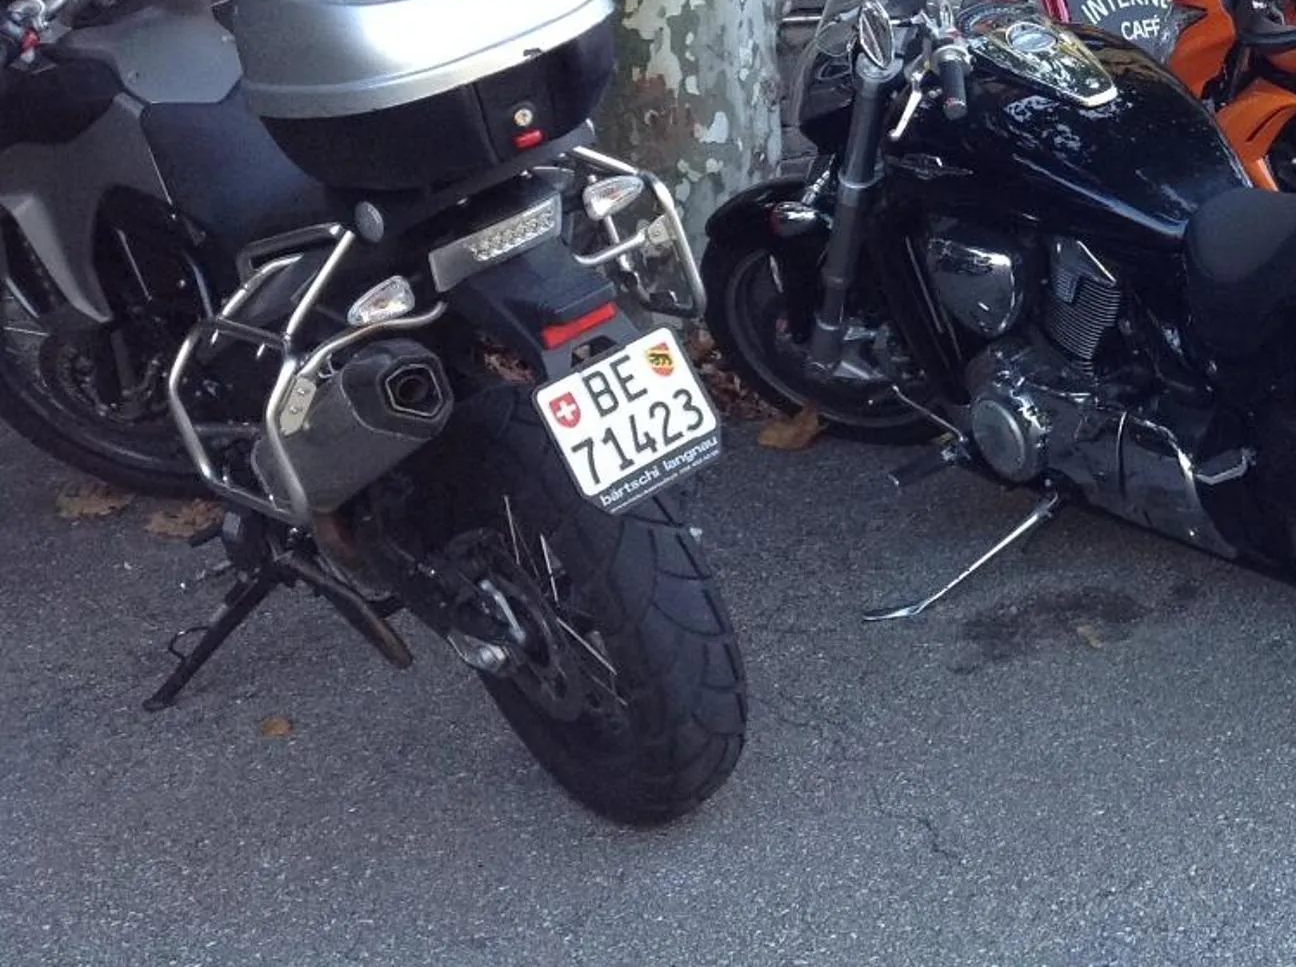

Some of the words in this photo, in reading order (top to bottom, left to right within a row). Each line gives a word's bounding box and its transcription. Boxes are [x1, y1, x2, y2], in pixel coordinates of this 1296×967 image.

[582, 354, 648, 417] BE
[571, 388, 703, 485] 71423
[662, 436, 718, 471] langnau
